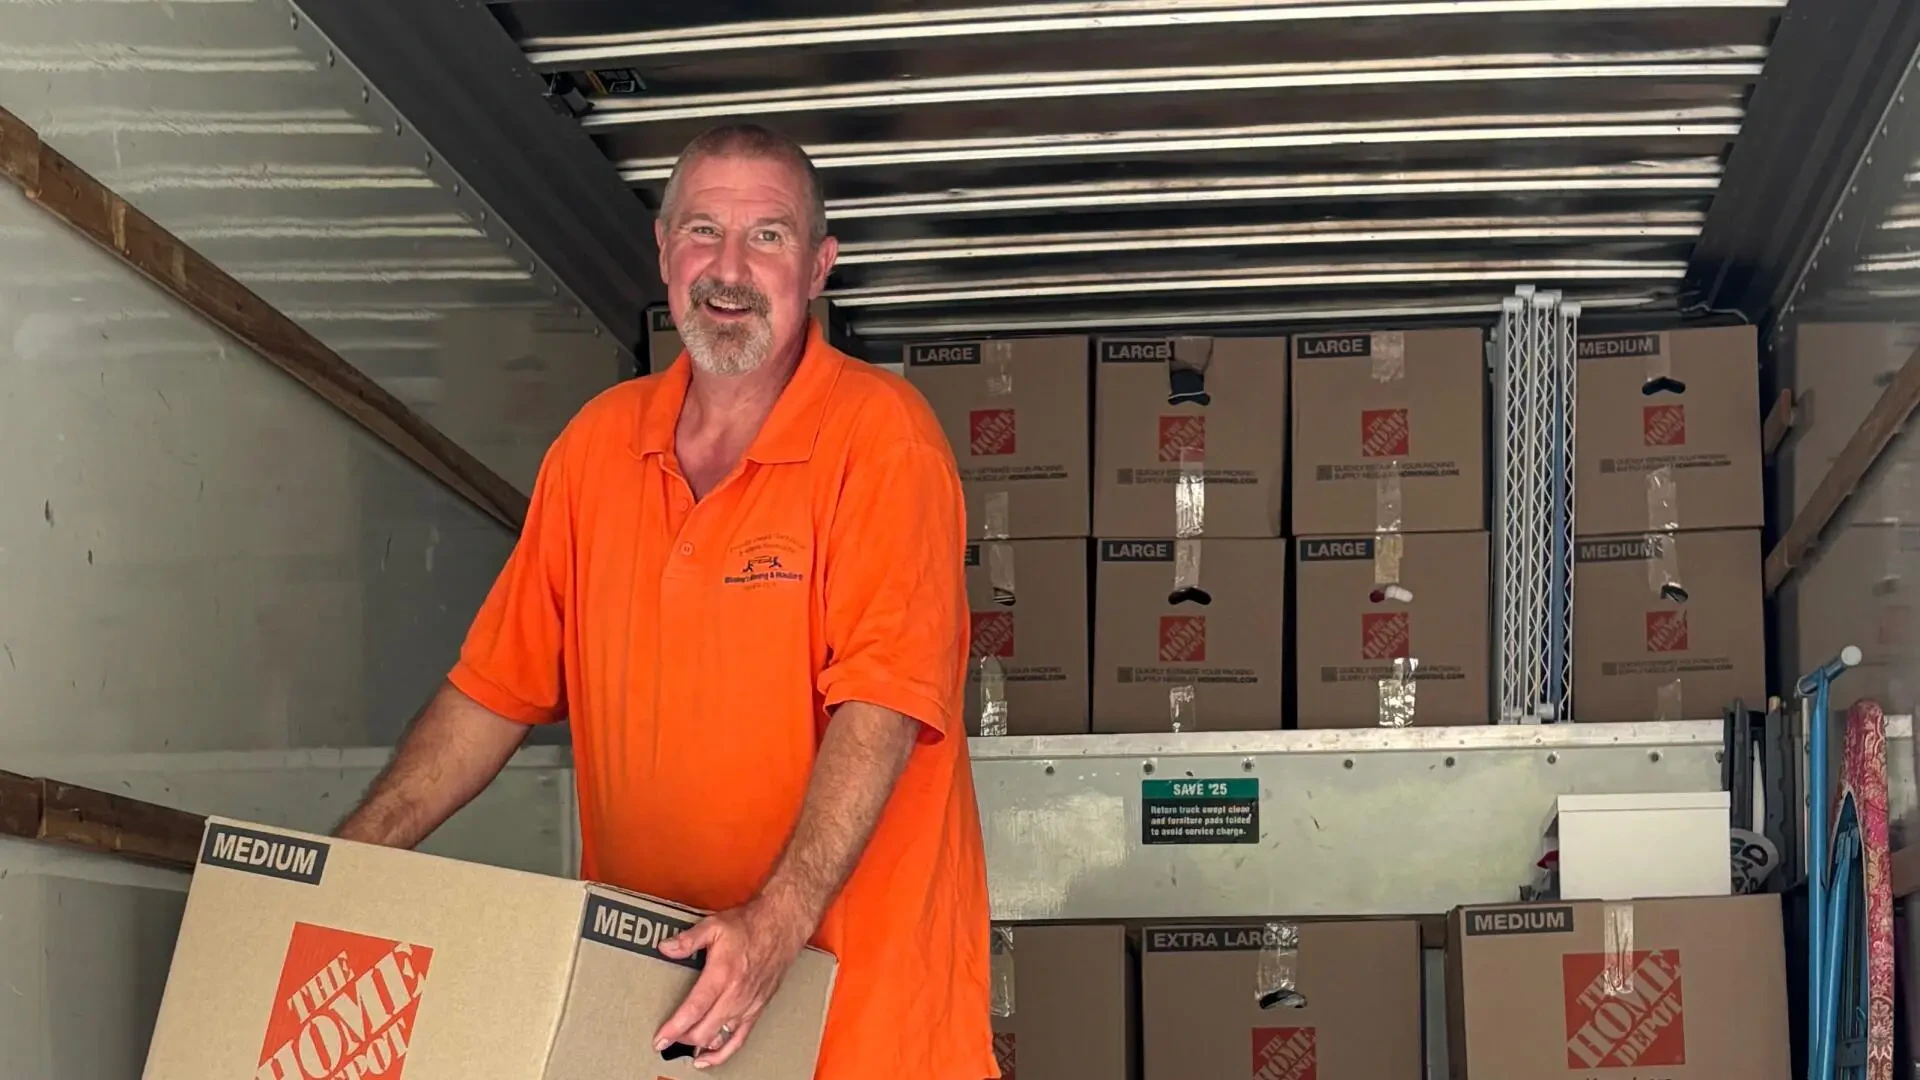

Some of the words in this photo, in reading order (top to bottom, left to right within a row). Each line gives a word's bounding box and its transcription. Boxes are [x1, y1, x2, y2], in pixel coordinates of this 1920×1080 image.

[916, 346, 973, 362] LARGE
[1108, 344, 1171, 359] LARGE
[1304, 338, 1364, 354] LARGE
[1579, 337, 1654, 356] MEDIUM
[1109, 543, 1168, 558] LARGE
[1307, 542, 1367, 557] LARGE
[1581, 542, 1655, 560] MEDIUM
[1173, 783, 1204, 796] SAVE
[1150, 805, 1177, 814] Return
[1179, 805, 1200, 814] truck
[1202, 805, 1226, 815] swept
[1228, 804, 1250, 813] clean
[1150, 816, 1166, 825] and
[1167, 816, 1202, 825] furniture
[1204, 816, 1224, 826] pads
[1225, 814, 1252, 825] folded
[1150, 828, 1159, 836] to
[1161, 827, 1183, 836] avoid
[1185, 827, 1214, 836] service
[212, 832, 318, 876] MEDIUM
[593, 904, 682, 950] MEDI
[1474, 911, 1565, 932] MEDIUM
[1153, 931, 1218, 948] EXTRA
[1224, 930, 1280, 947] LARG
[287, 949, 356, 1025] THE
[255, 941, 427, 1080] HOME
[1567, 950, 1682, 1069] HOME
[1612, 992, 1683, 1068] DEPOT
[1256, 1033, 1285, 1060] THE
